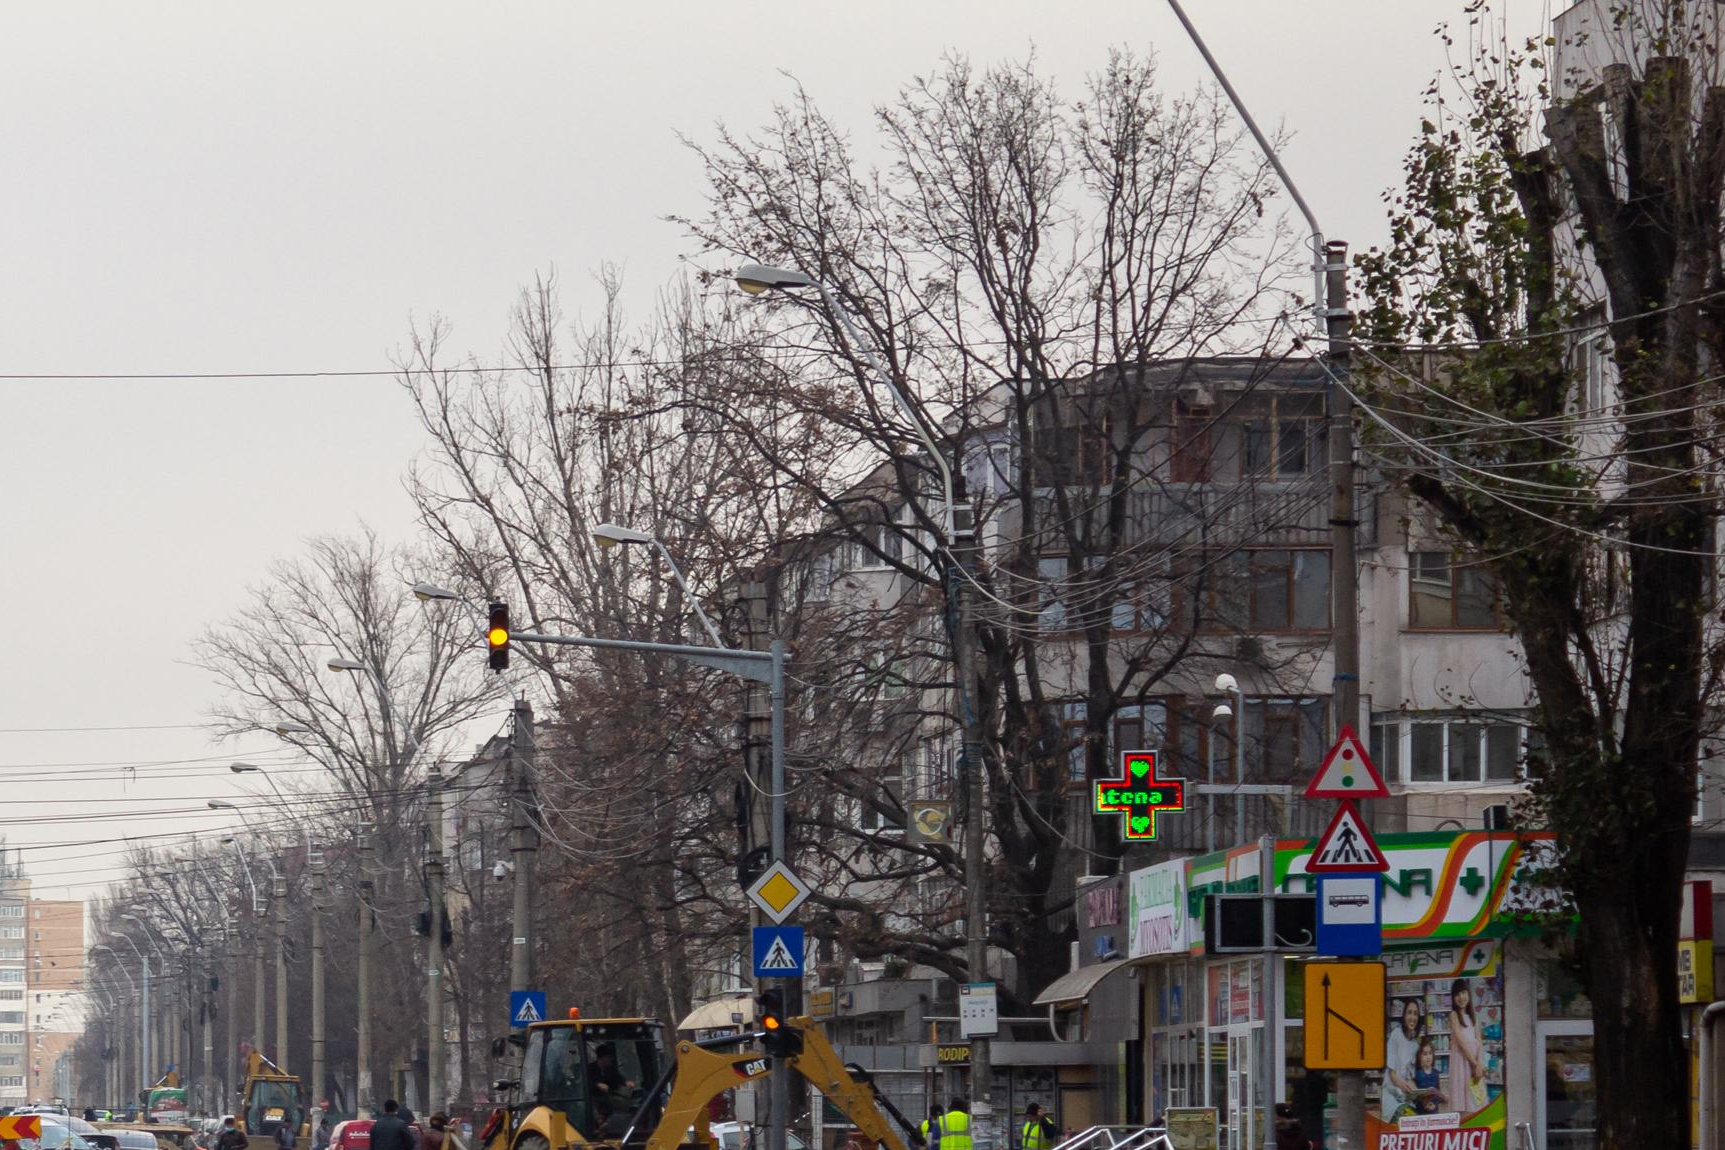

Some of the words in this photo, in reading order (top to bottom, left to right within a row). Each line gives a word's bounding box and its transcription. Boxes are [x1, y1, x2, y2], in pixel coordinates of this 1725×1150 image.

[1379, 949, 1454, 969] CATENA
[937, 1047, 972, 1062] RODIP
[746, 1059, 766, 1076] CAT
